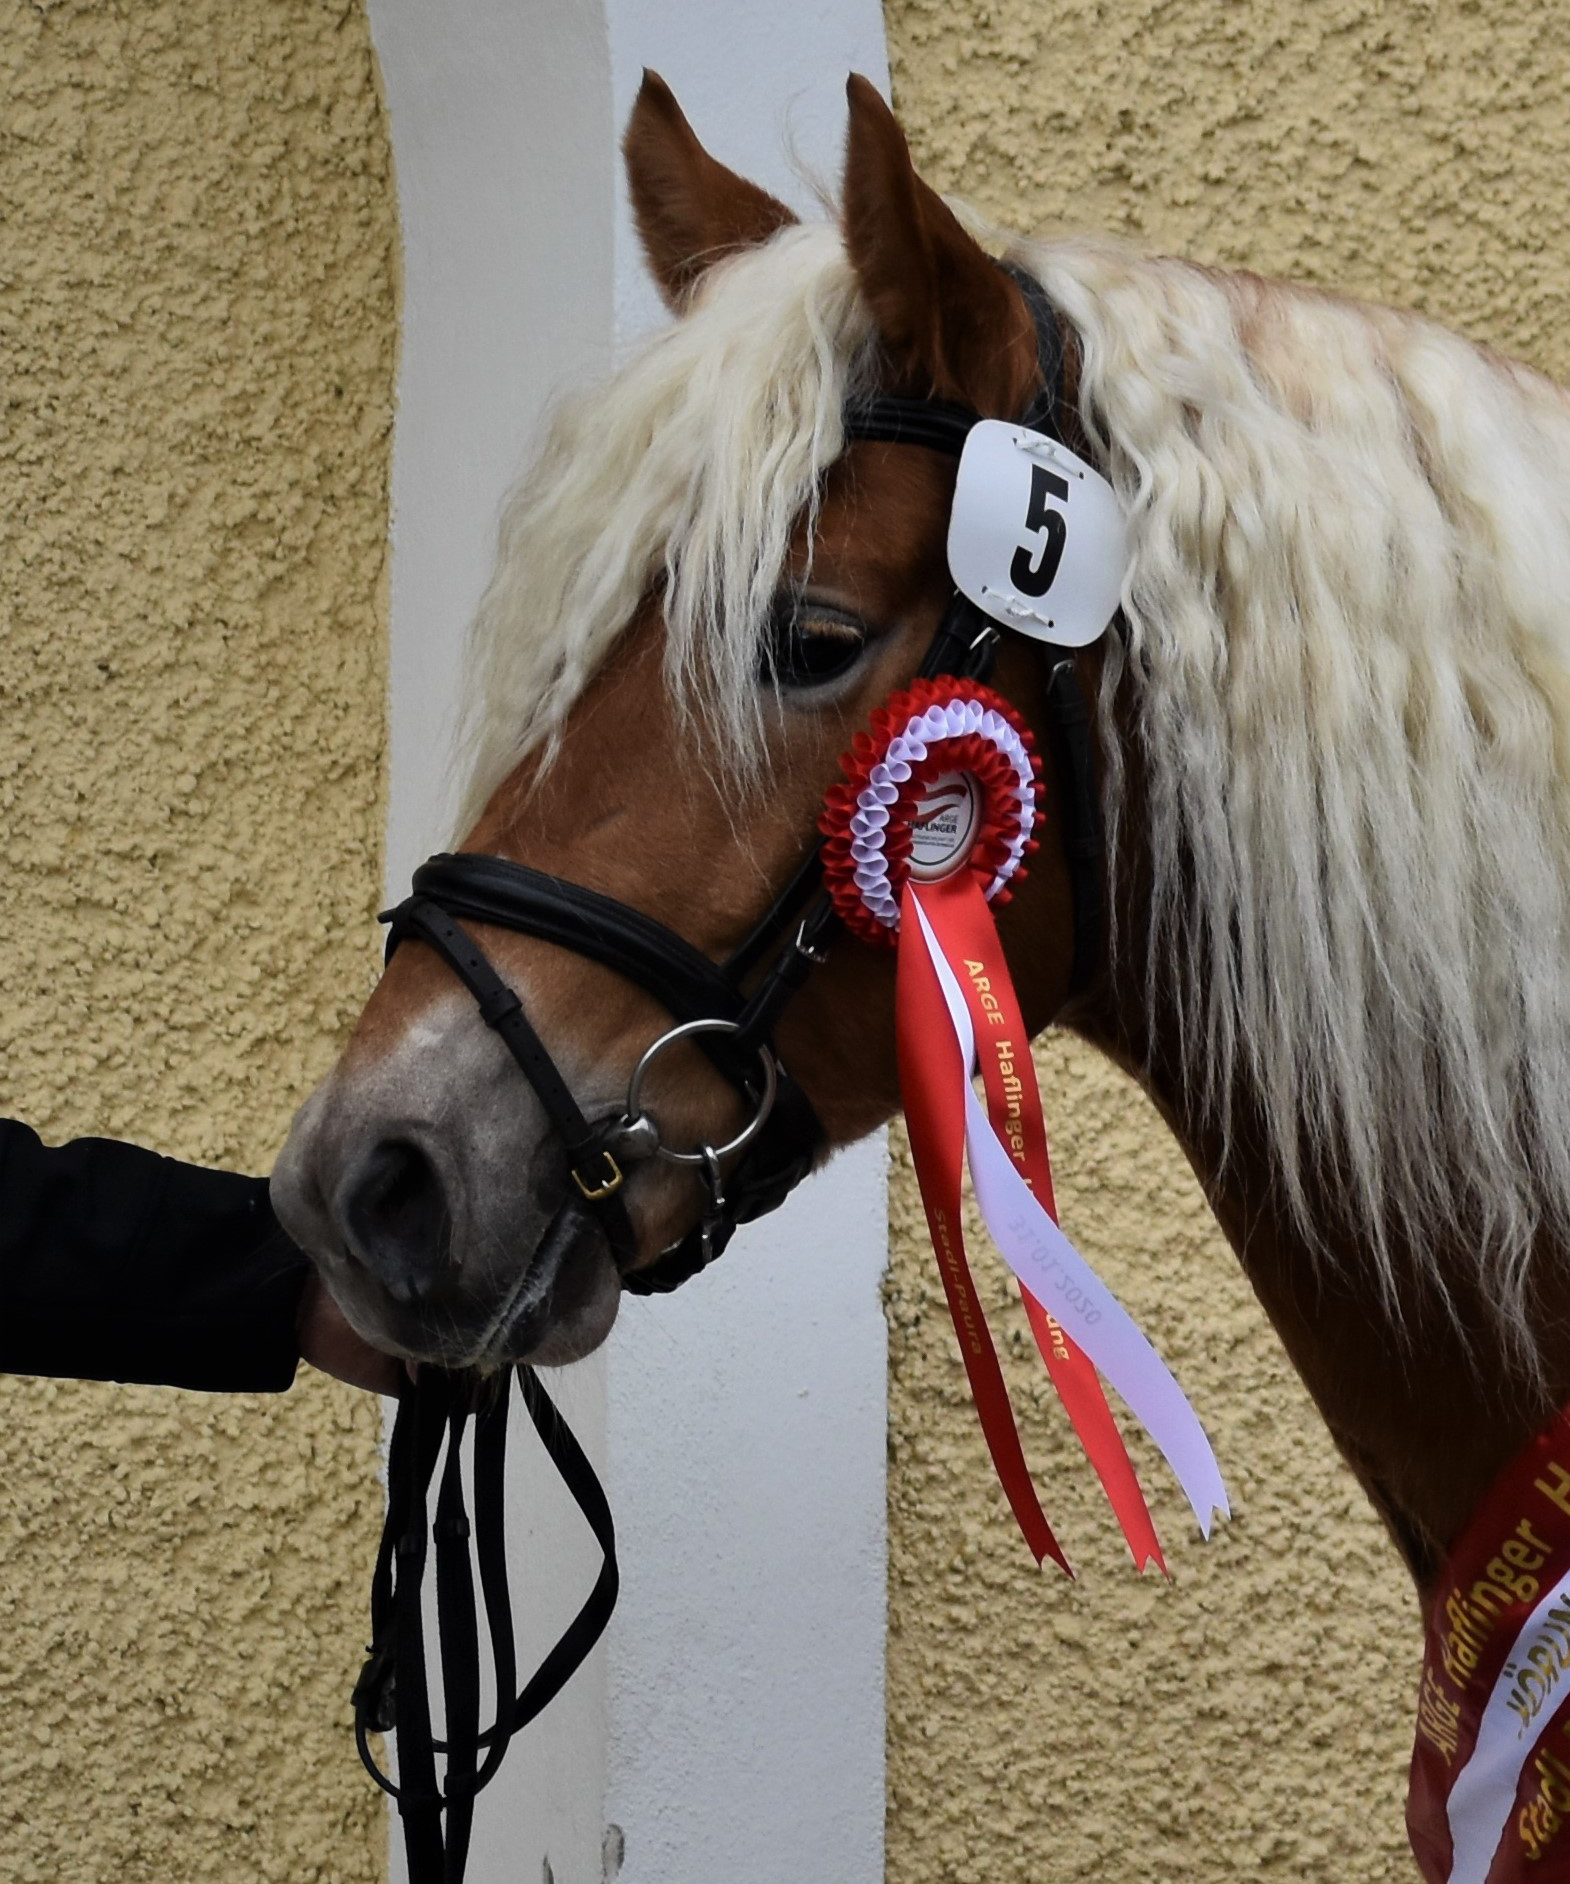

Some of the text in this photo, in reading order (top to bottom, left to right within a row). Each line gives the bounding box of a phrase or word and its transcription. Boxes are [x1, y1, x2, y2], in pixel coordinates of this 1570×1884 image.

[1010, 463, 1069, 598] 5
[964, 959, 1026, 1162] ARGE Haflinger
[934, 1207, 982, 1355] Stadl-Paura
